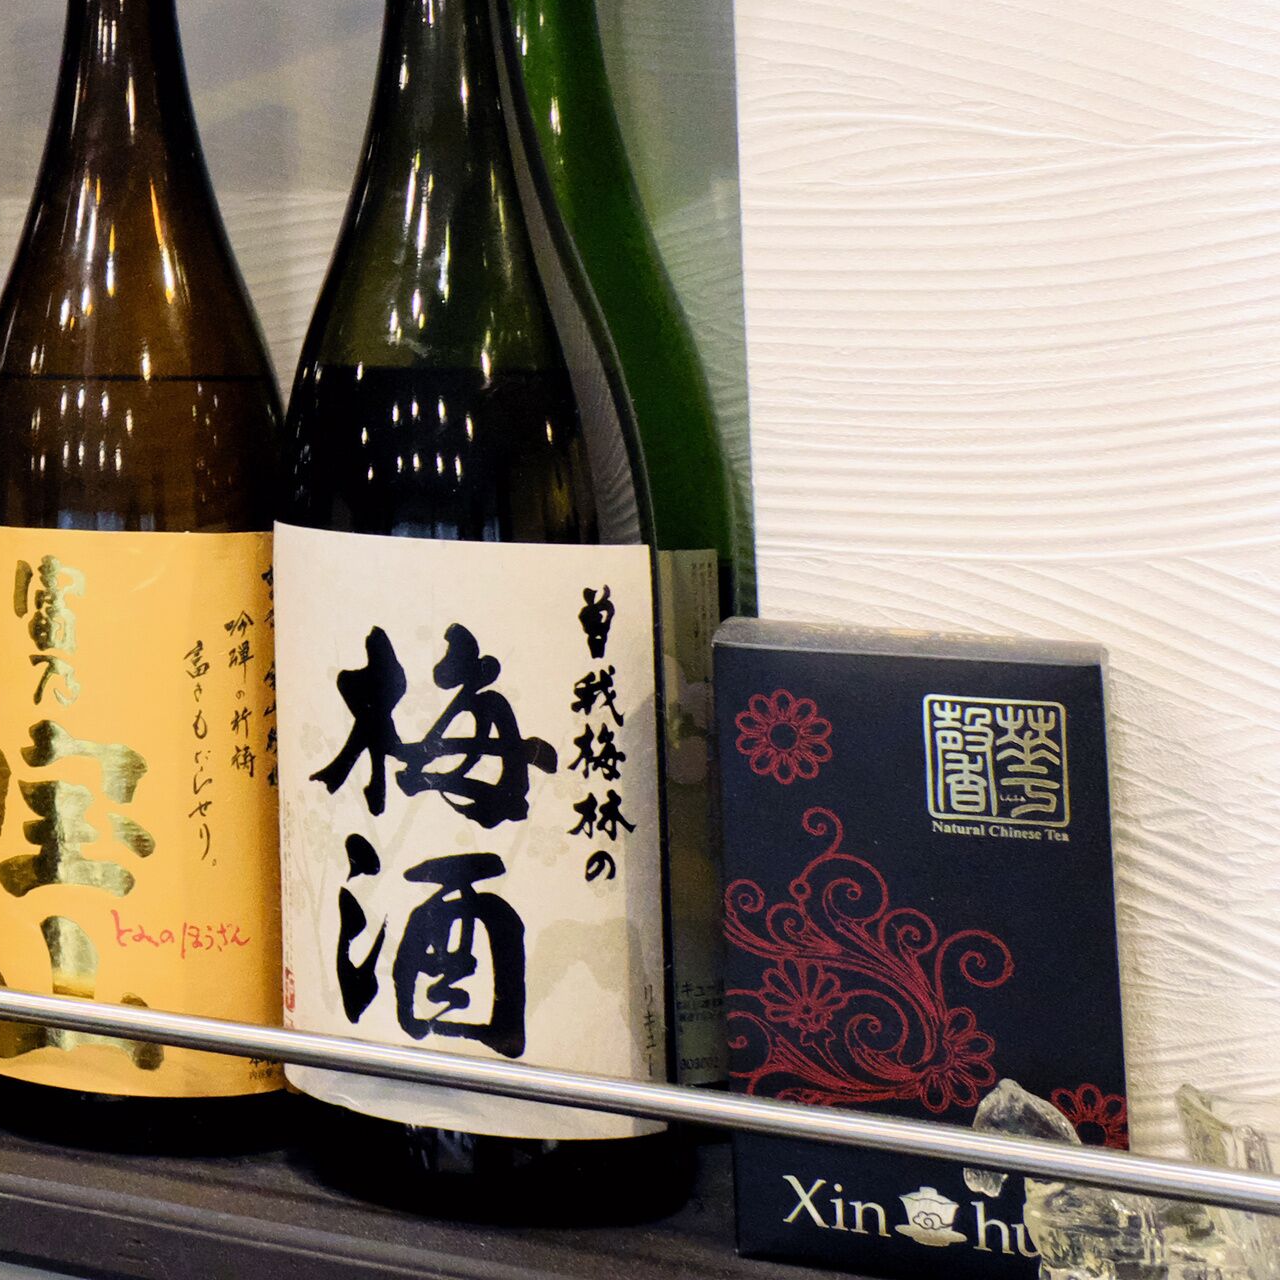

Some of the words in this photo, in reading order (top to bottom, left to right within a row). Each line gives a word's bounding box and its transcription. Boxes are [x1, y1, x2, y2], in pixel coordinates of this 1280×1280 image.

[308, 623, 558, 1059] 梅酒
[931, 820, 985, 837] Natural
[986, 824, 1042, 840] Chinese
[1044, 828, 1070, 842] Tea
[782, 1173, 892, 1238] Xin
